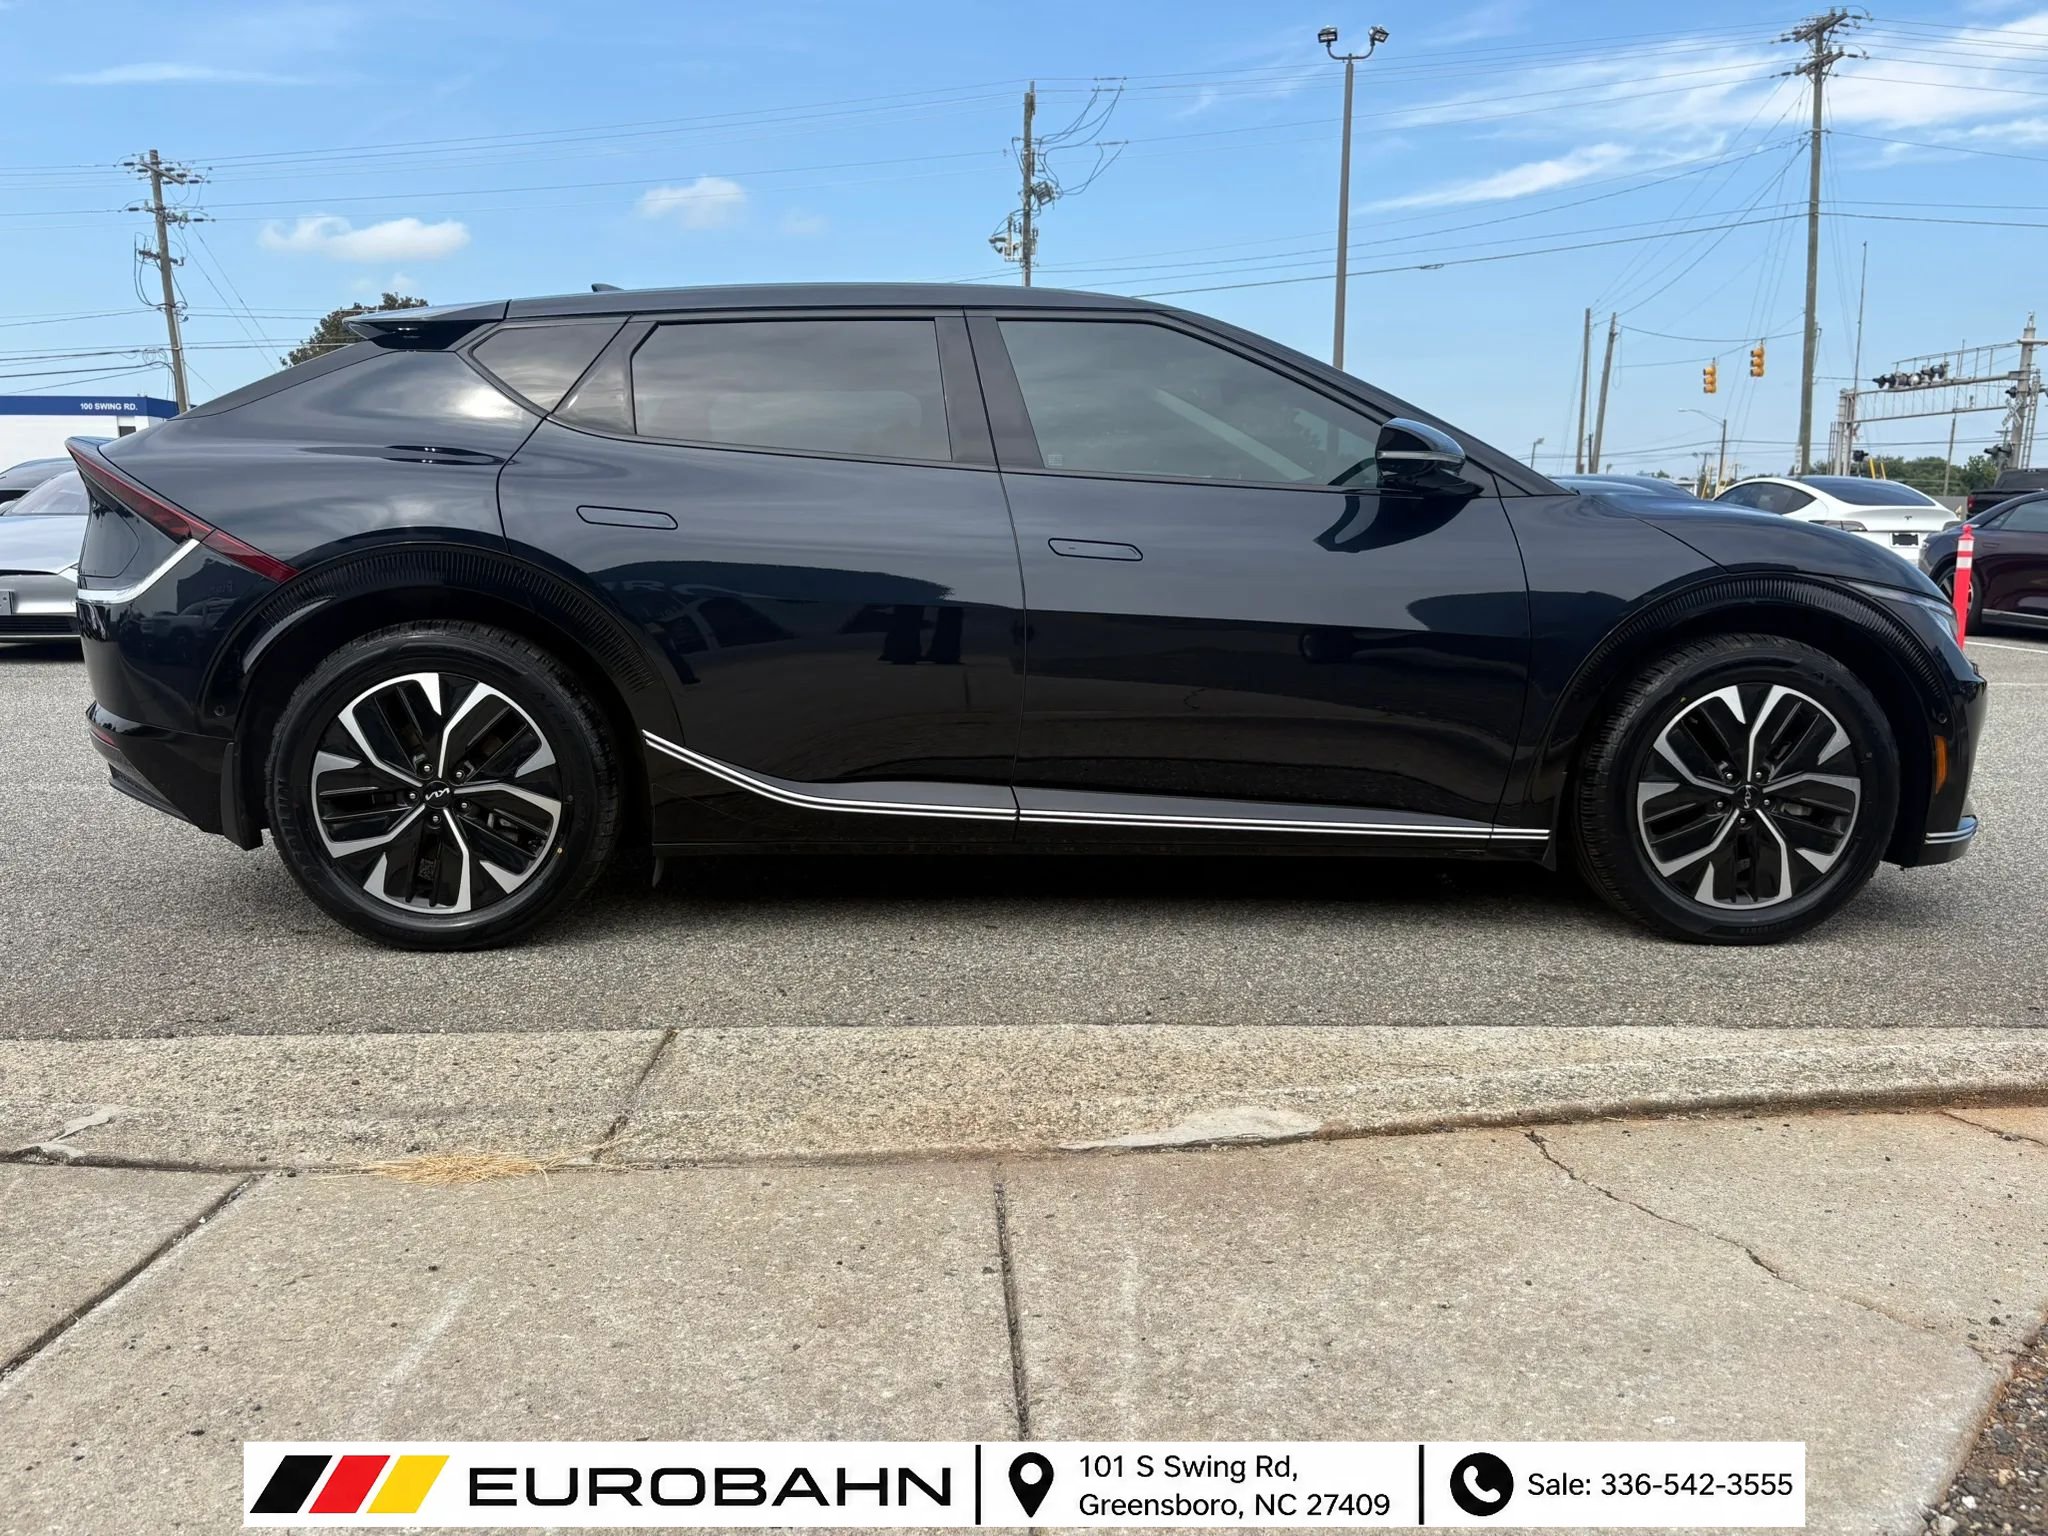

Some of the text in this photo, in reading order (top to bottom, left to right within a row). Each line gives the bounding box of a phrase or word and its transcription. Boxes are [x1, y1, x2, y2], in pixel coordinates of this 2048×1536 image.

[80, 402, 138, 411] 100 SWING RD.
